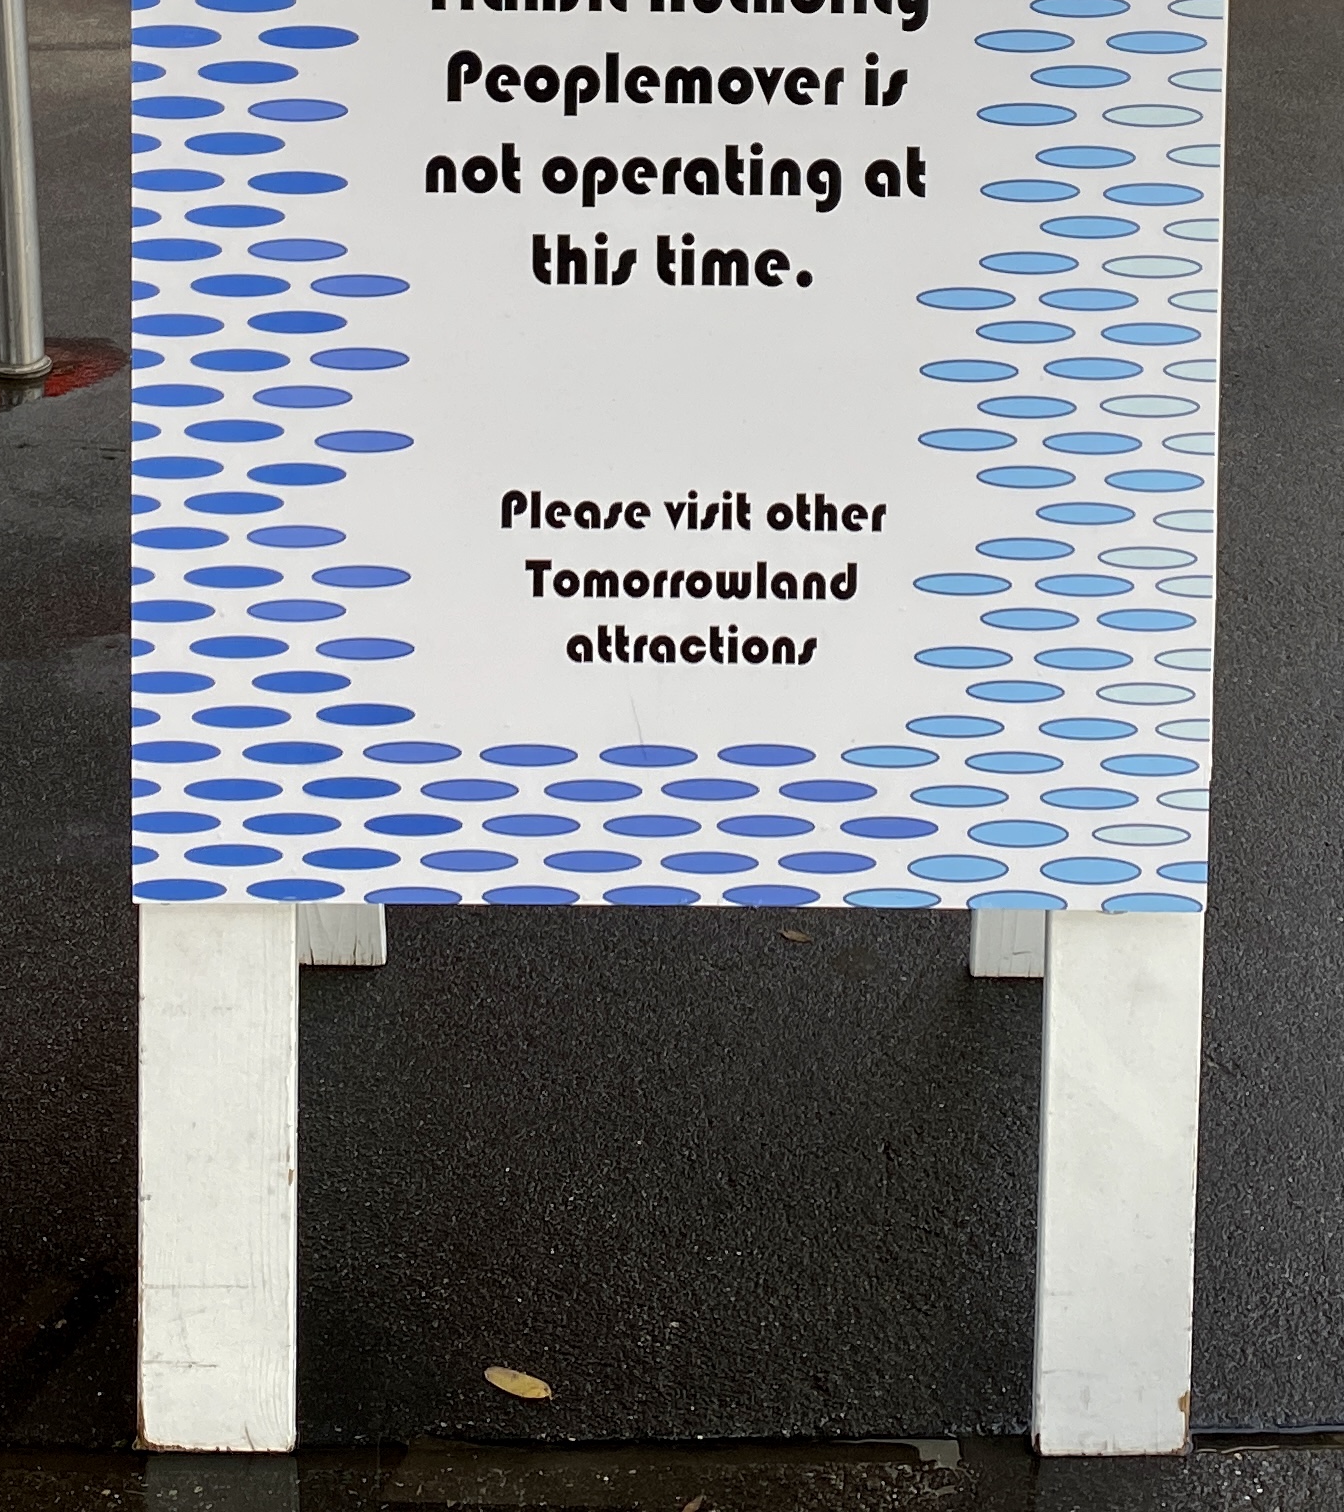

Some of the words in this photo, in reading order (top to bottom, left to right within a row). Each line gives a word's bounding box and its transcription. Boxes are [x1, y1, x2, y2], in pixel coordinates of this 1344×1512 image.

[446, 49, 845, 117] Peoplemover
[864, 51, 908, 107] is
[425, 142, 521, 194] not
[541, 141, 843, 213] operating
[864, 145, 927, 198] at
[532, 231, 637, 286] this
[656, 232, 813, 288] time.
[501, 490, 651, 530] Please
[663, 490, 751, 531] visit
[766, 493, 887, 532] other
[525, 559, 858, 601] Tomorrowland
[566, 624, 818, 665] attractions
